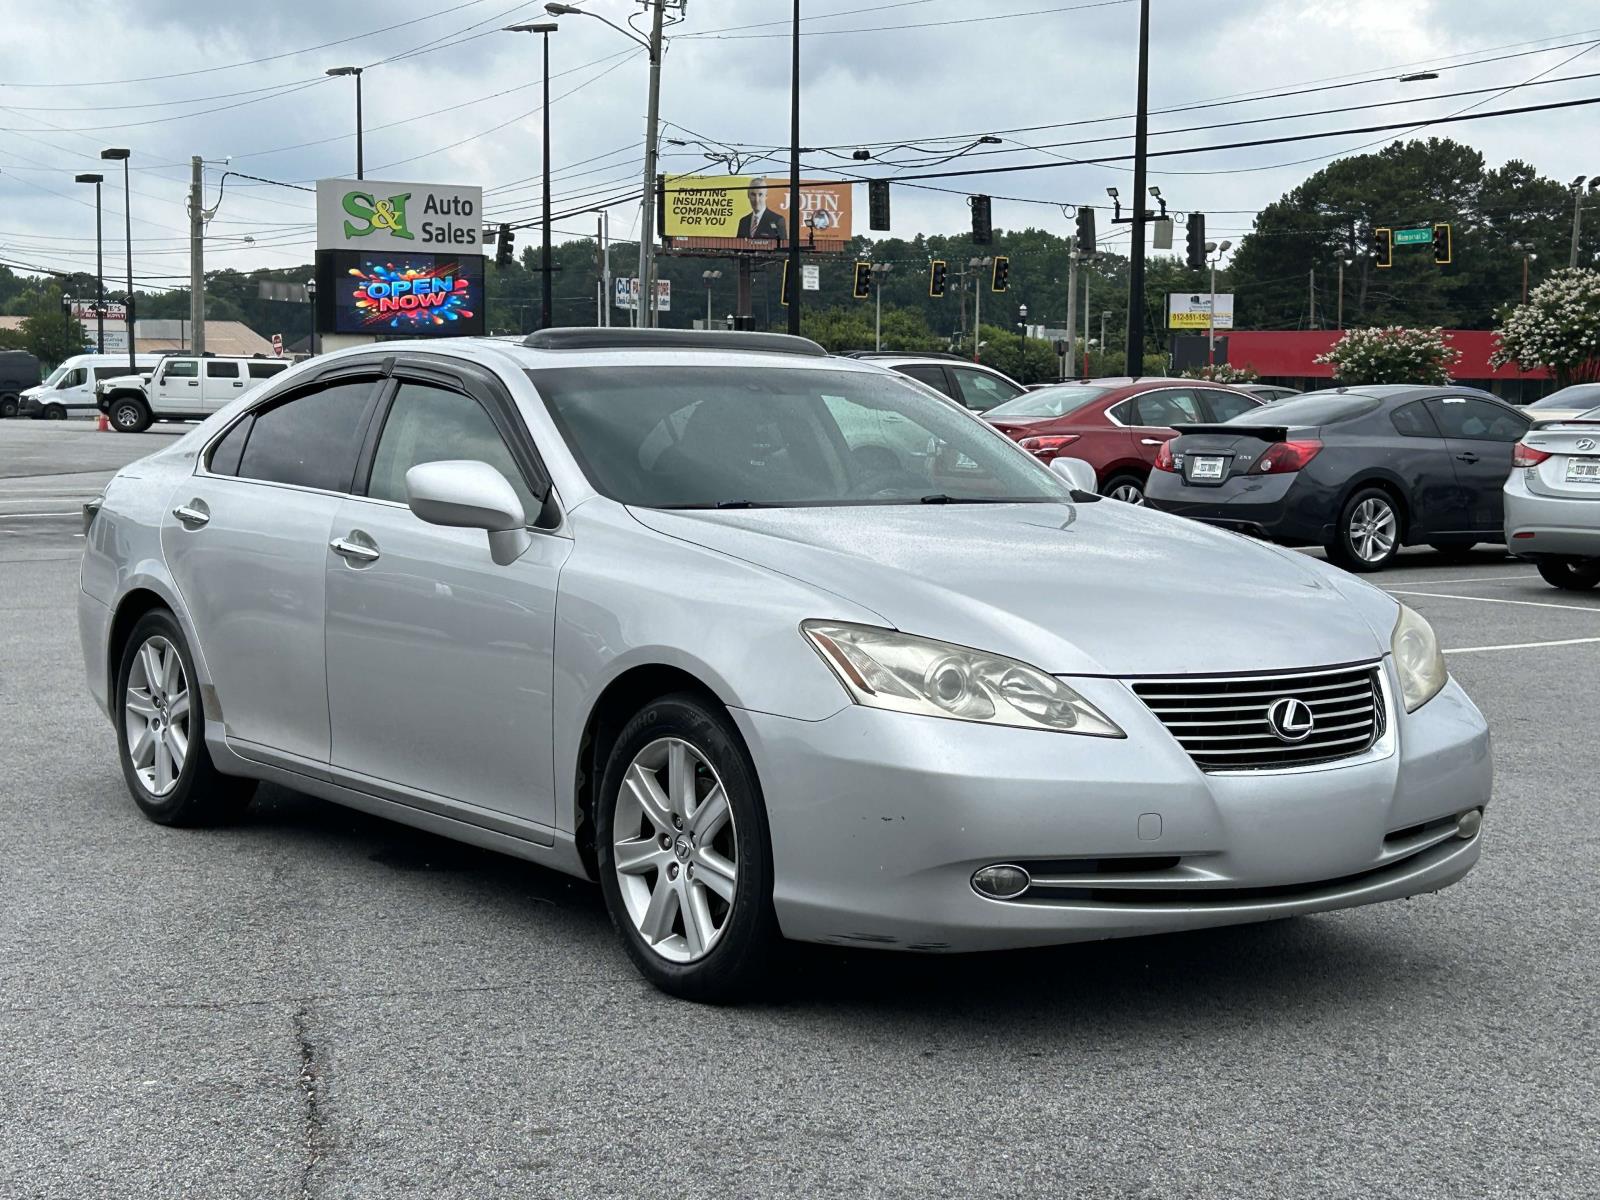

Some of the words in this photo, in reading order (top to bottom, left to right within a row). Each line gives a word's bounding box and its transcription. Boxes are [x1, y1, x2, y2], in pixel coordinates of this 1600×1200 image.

[424, 193, 474, 217] Auto
[673, 196, 734, 207] INSURANCE
[673, 206, 734, 217] COMPANIES
[342, 191, 415, 241] S&I
[680, 216, 702, 225] FOR
[705, 217, 727, 226] YOU
[422, 222, 477, 245] Sales
[367, 275, 453, 299] OPEN
[379, 291, 446, 312] NOW
